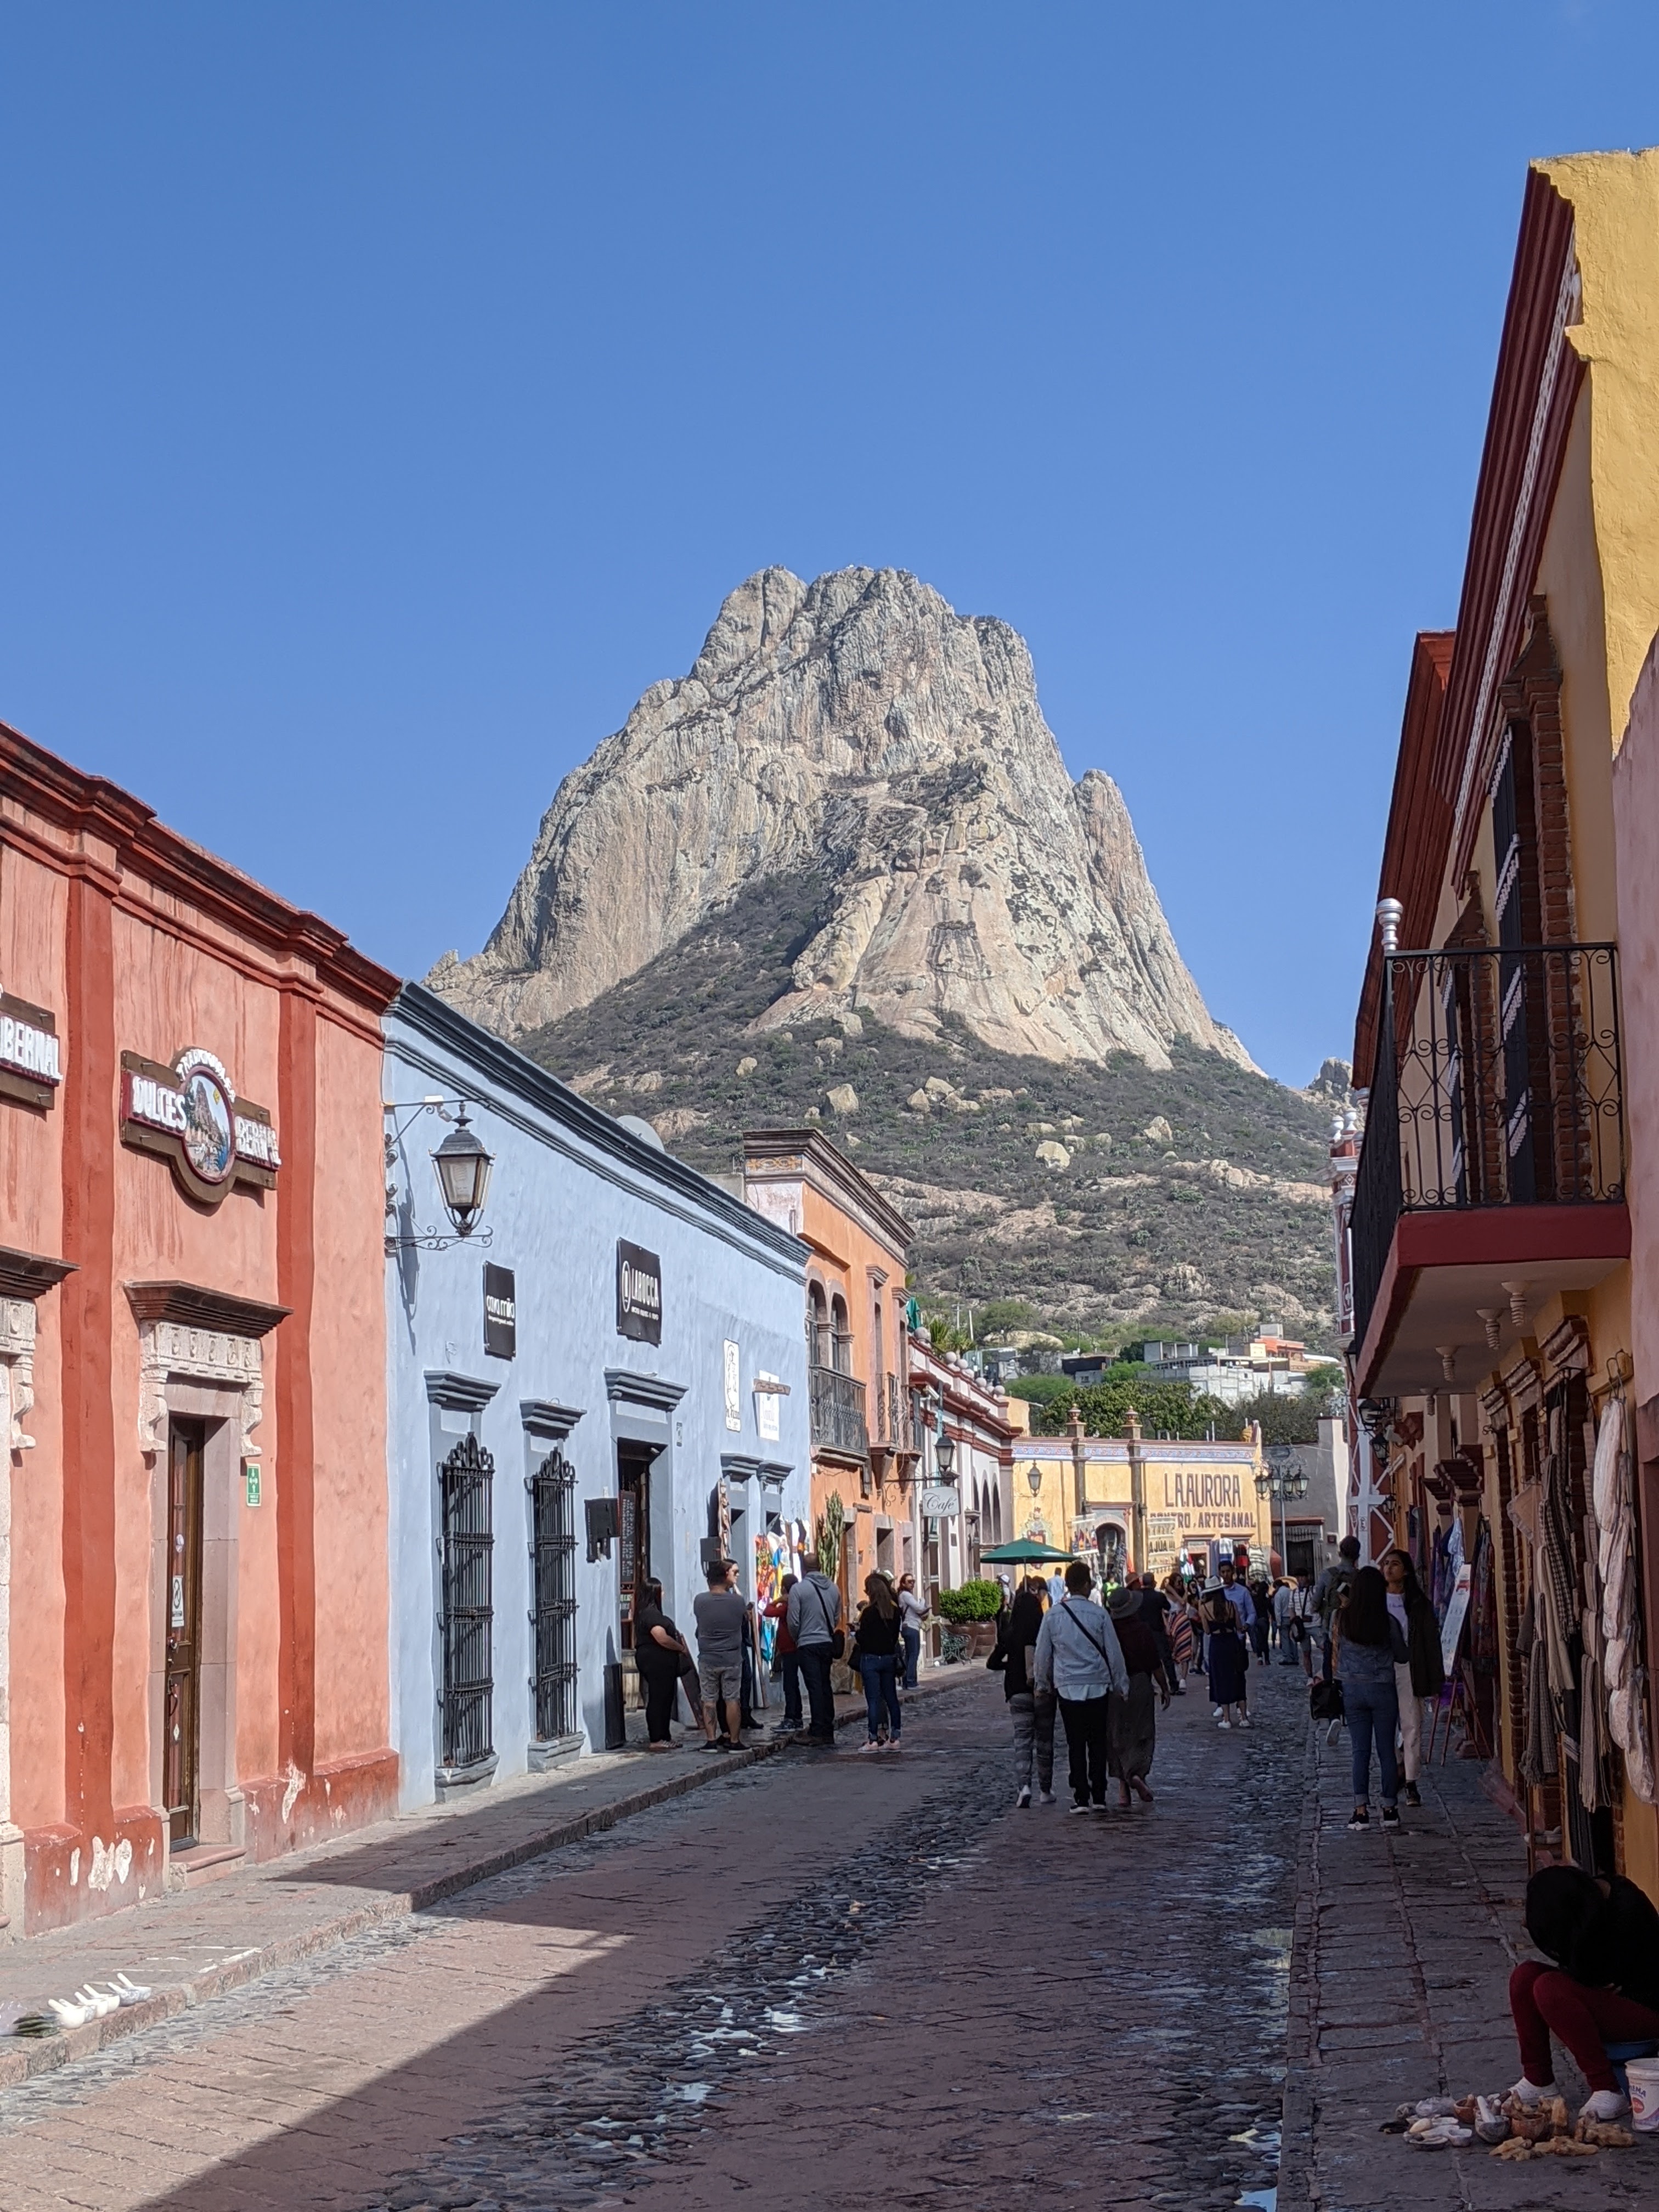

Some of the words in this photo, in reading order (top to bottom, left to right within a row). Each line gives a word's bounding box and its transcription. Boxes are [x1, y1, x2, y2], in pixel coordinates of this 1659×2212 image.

[1, 1016, 63, 1081] BERNAL
[132, 1075, 187, 1131] DULCES
[924, 1493, 957, 1514] Café
[1187, 1473, 1241, 1508] AURORA
[1198, 1512, 1256, 1528] ARTESANAL
